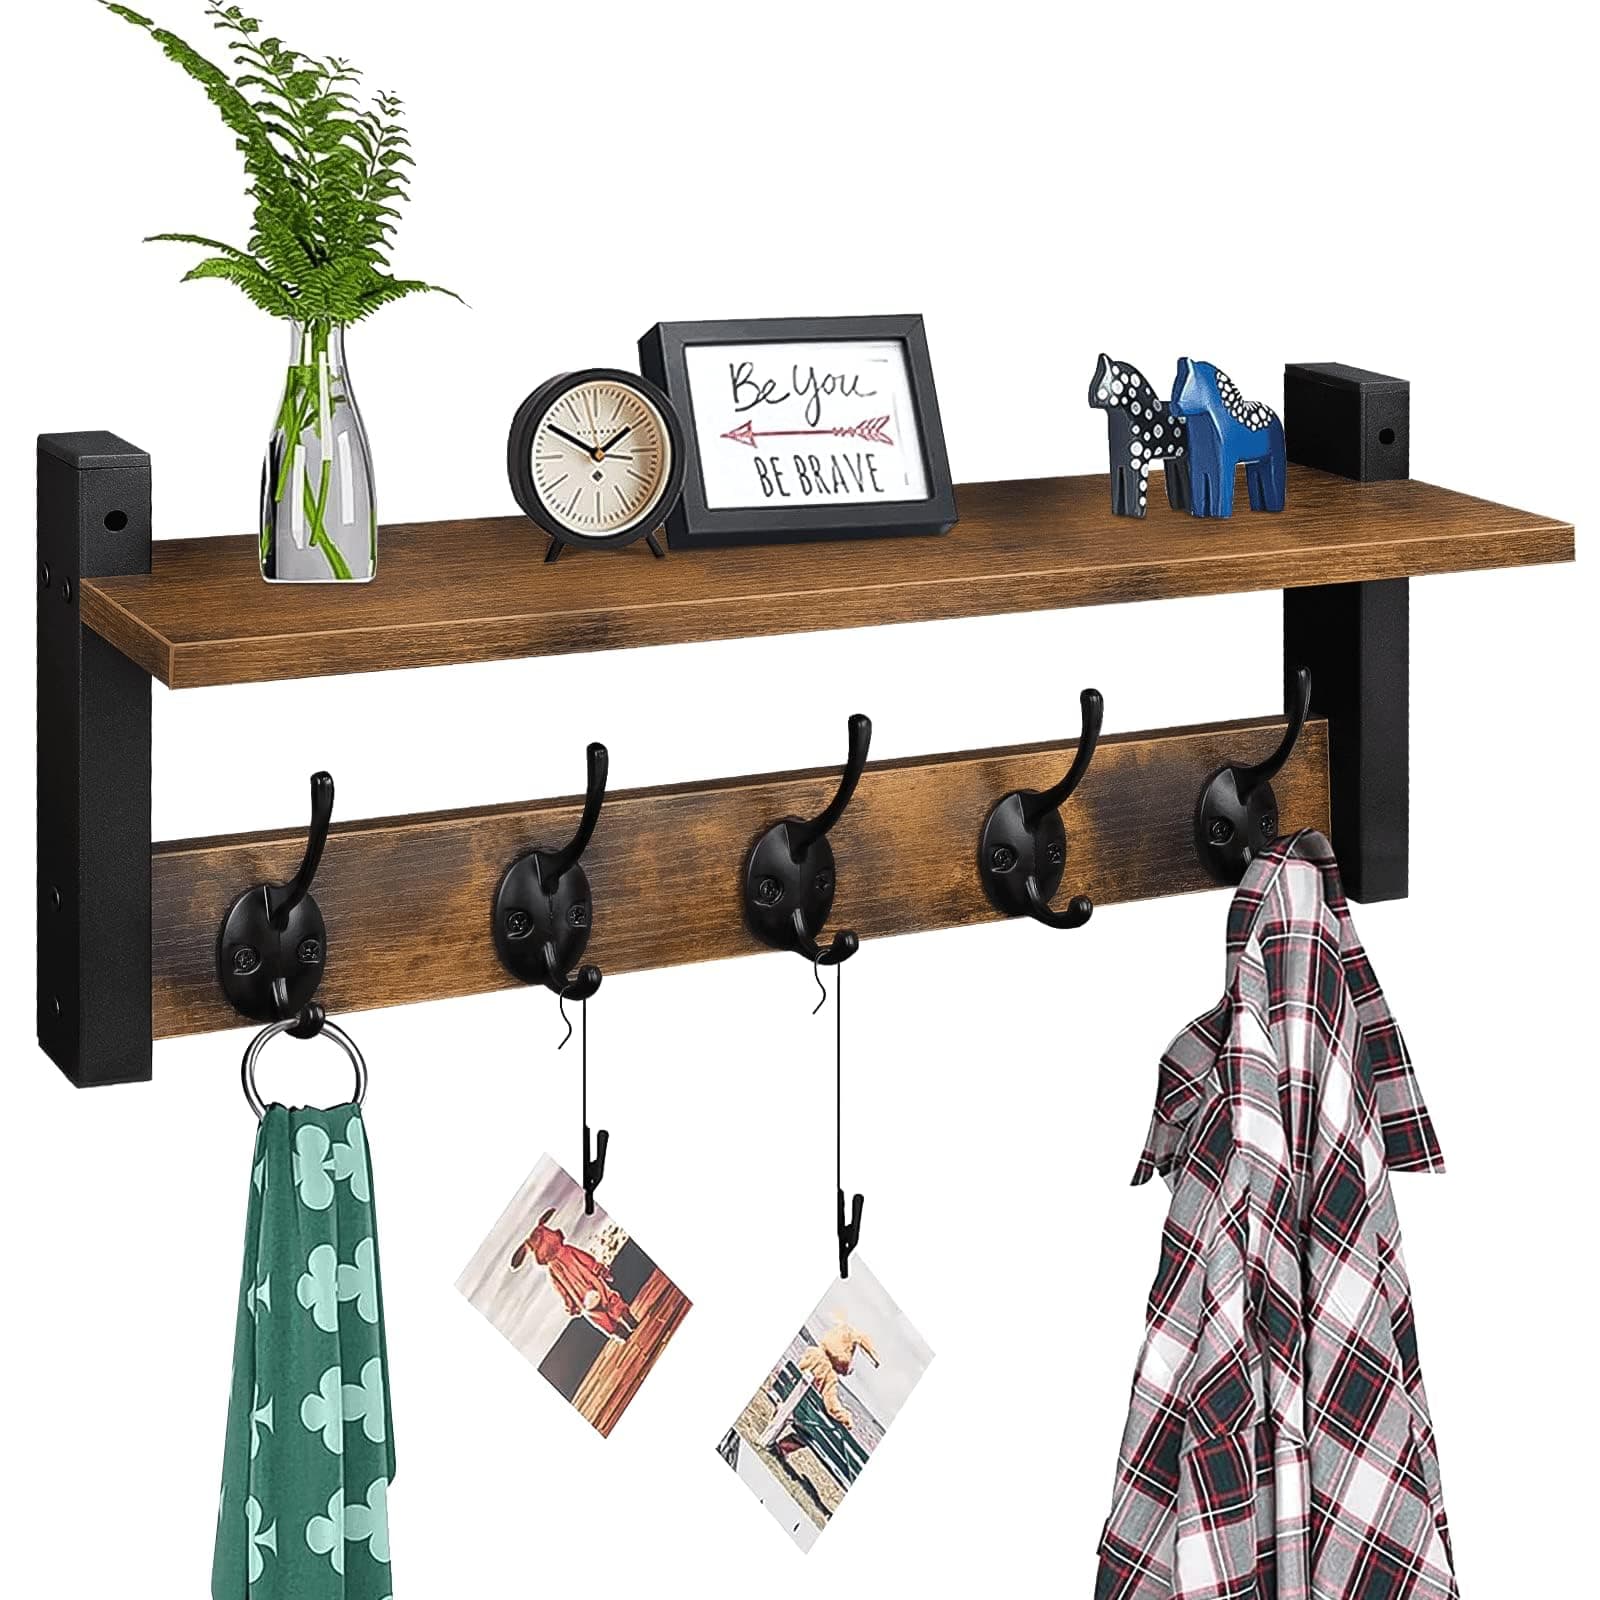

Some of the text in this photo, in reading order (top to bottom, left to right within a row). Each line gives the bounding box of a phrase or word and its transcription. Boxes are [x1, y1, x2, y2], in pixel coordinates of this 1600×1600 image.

[729, 361, 791, 412] Be
[754, 453, 885, 497] BE BRAVE
